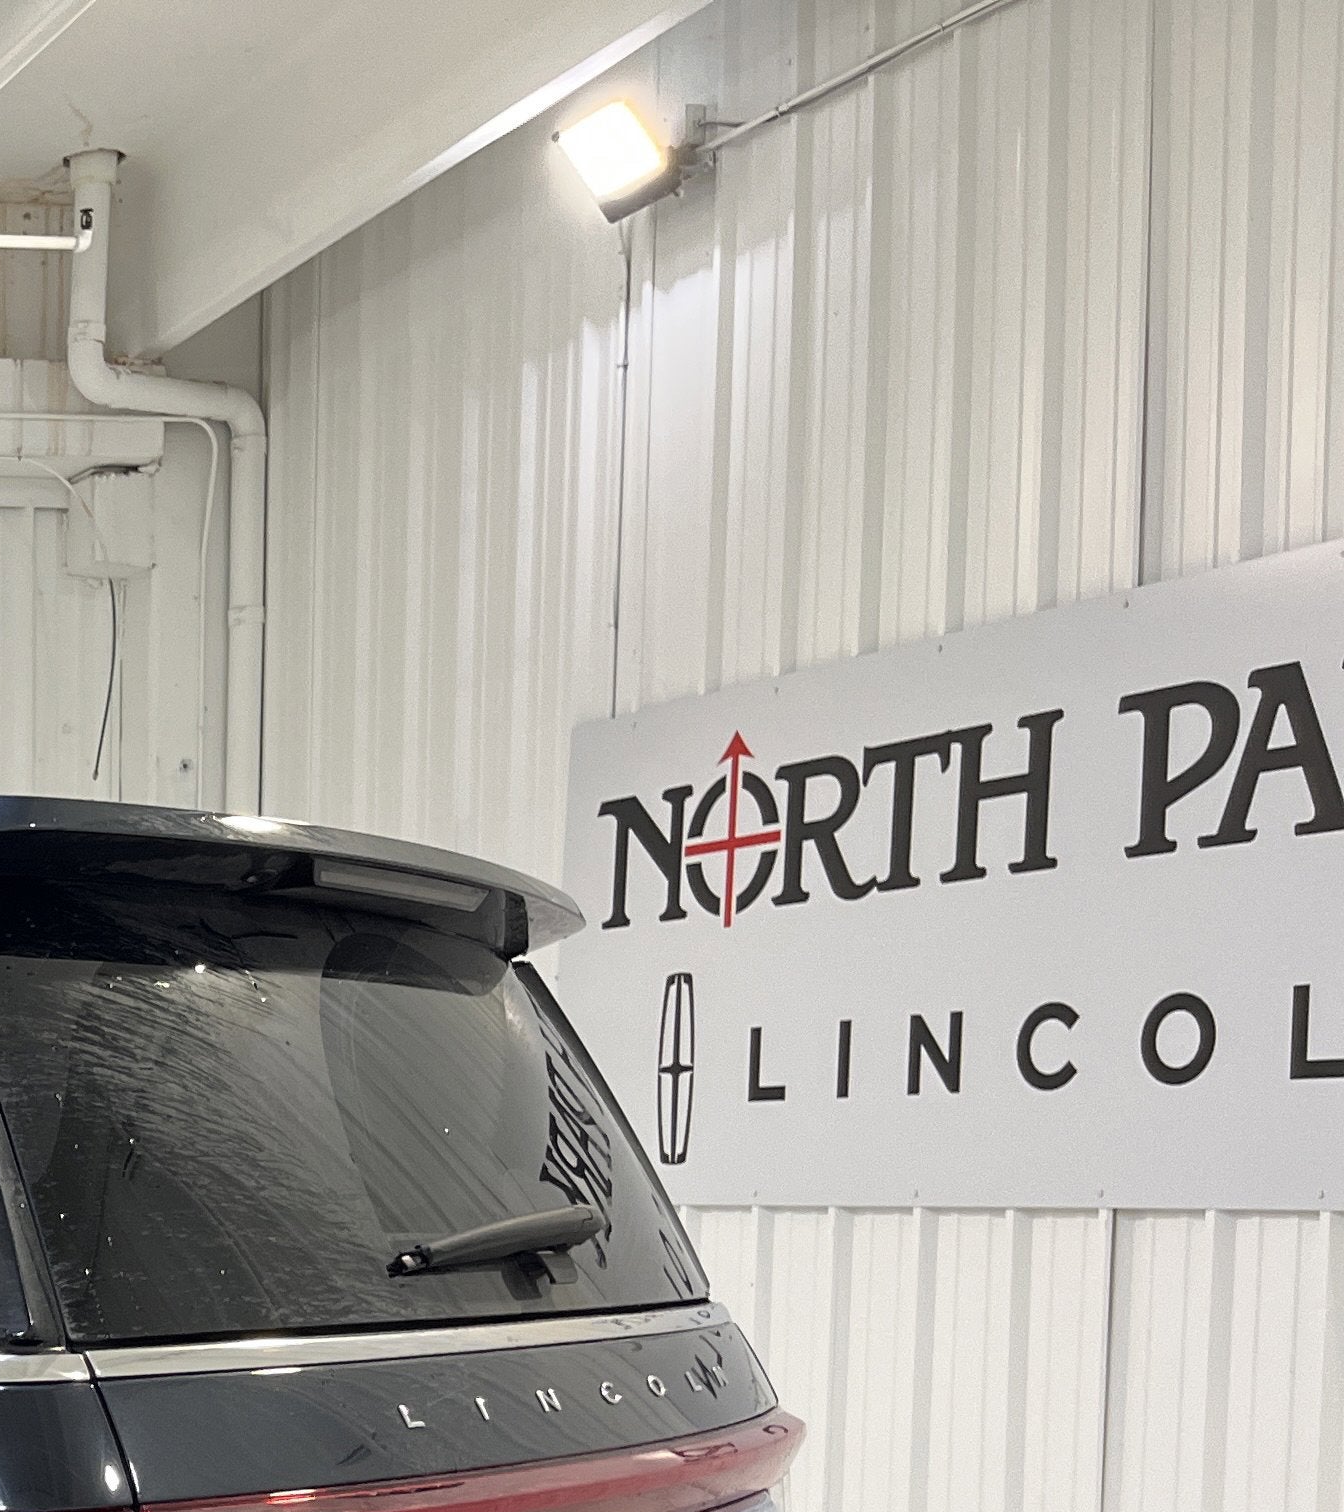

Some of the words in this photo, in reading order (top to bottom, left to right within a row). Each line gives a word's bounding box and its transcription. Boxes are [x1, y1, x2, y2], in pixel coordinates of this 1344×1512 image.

[597, 708, 1065, 930] NORTH
[1118, 658, 1344, 858] PA
[748, 984, 1344, 1101] LINCOL
[397, 1366, 729, 1429] LINCOLN
